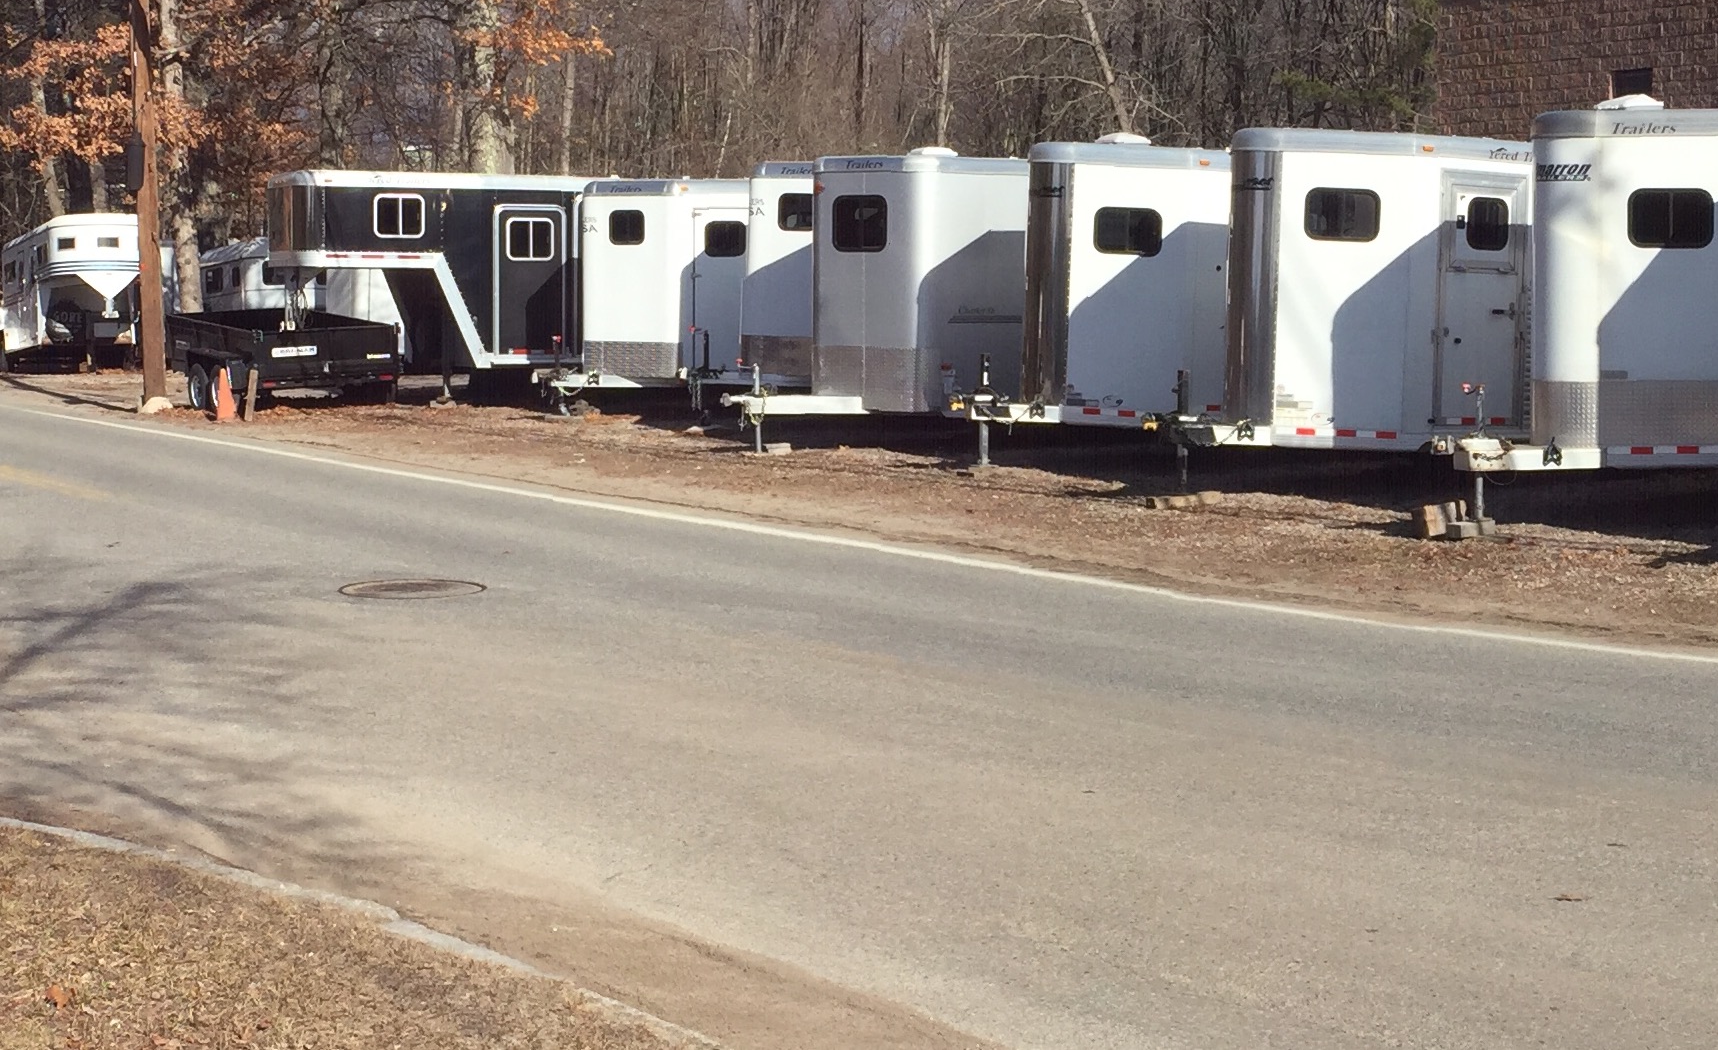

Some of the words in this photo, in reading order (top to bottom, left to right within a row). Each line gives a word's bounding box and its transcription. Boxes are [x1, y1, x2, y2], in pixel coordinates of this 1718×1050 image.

[1612, 121, 1677, 136] Trailers
[1489, 147, 1519, 161] Yered
[845, 160, 884, 170] Trailers
